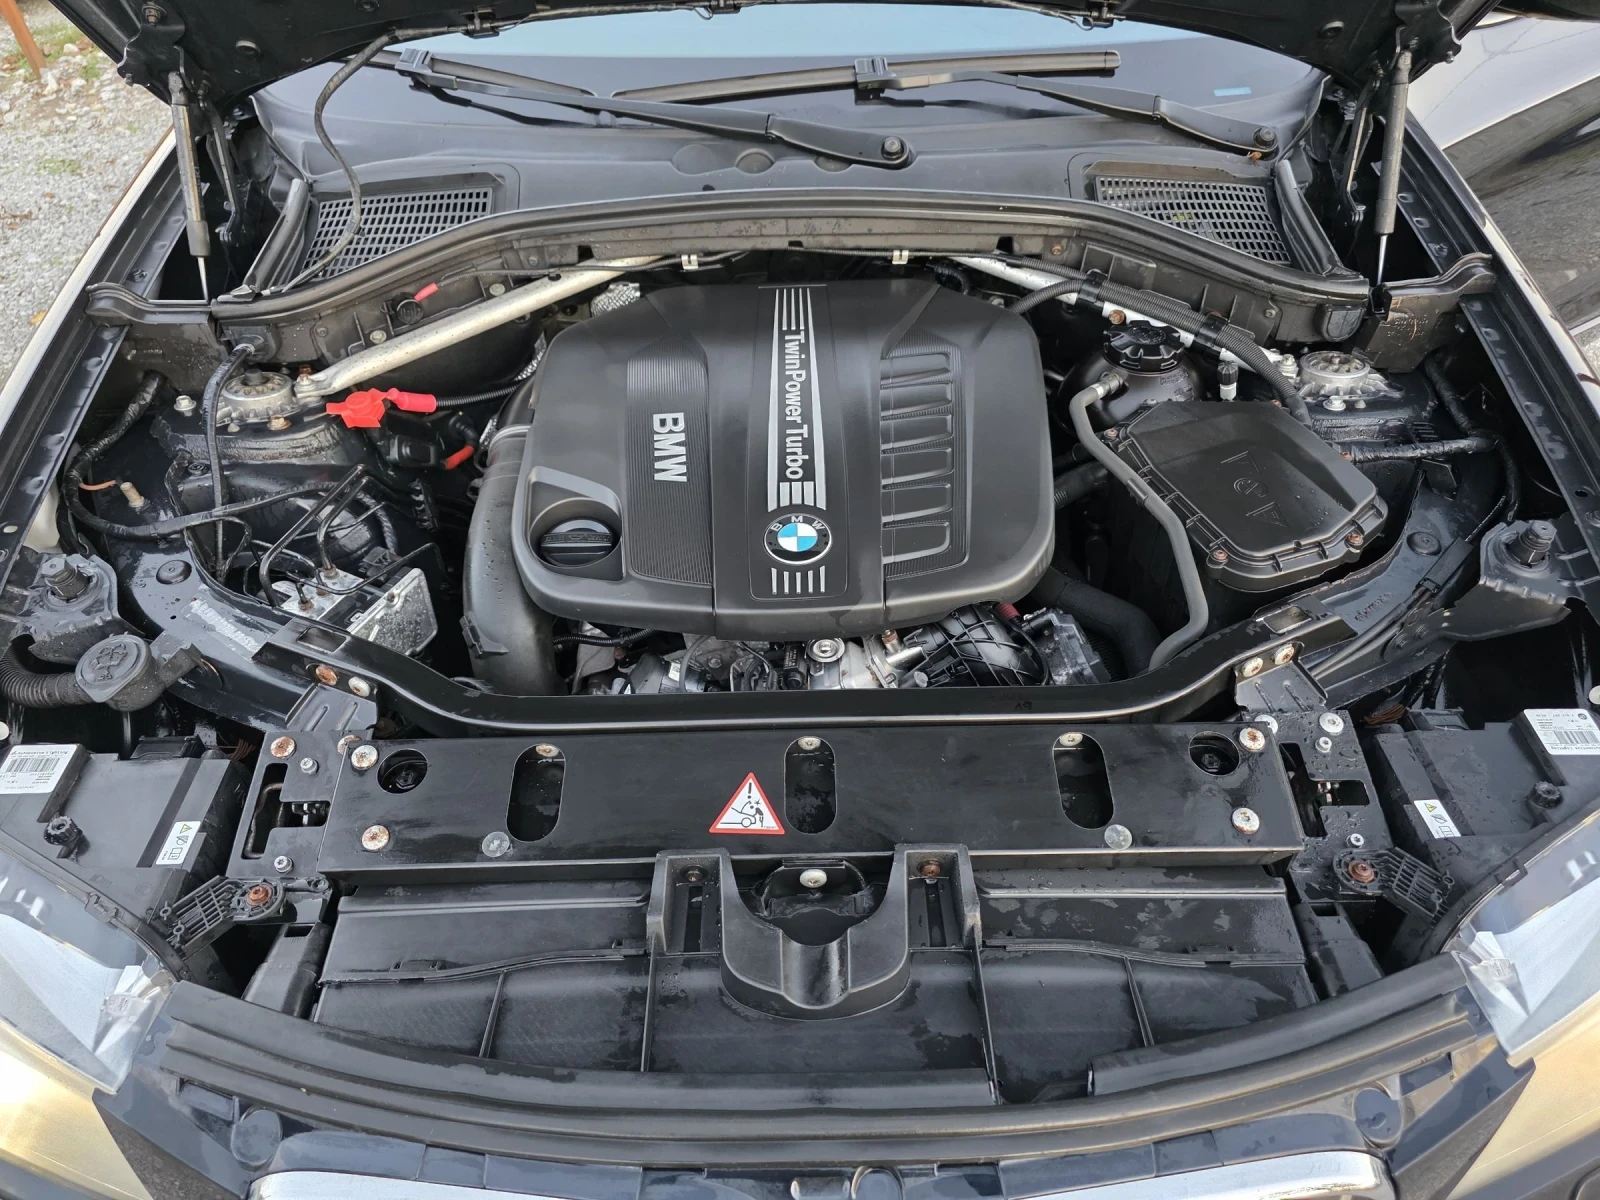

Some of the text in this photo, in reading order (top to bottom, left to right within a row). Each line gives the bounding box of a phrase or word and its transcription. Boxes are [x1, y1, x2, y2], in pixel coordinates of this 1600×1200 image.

[784, 330, 810, 480] TwinPower Turbo
[652, 412, 688, 483] BMW
[770, 515, 826, 532] BMW
